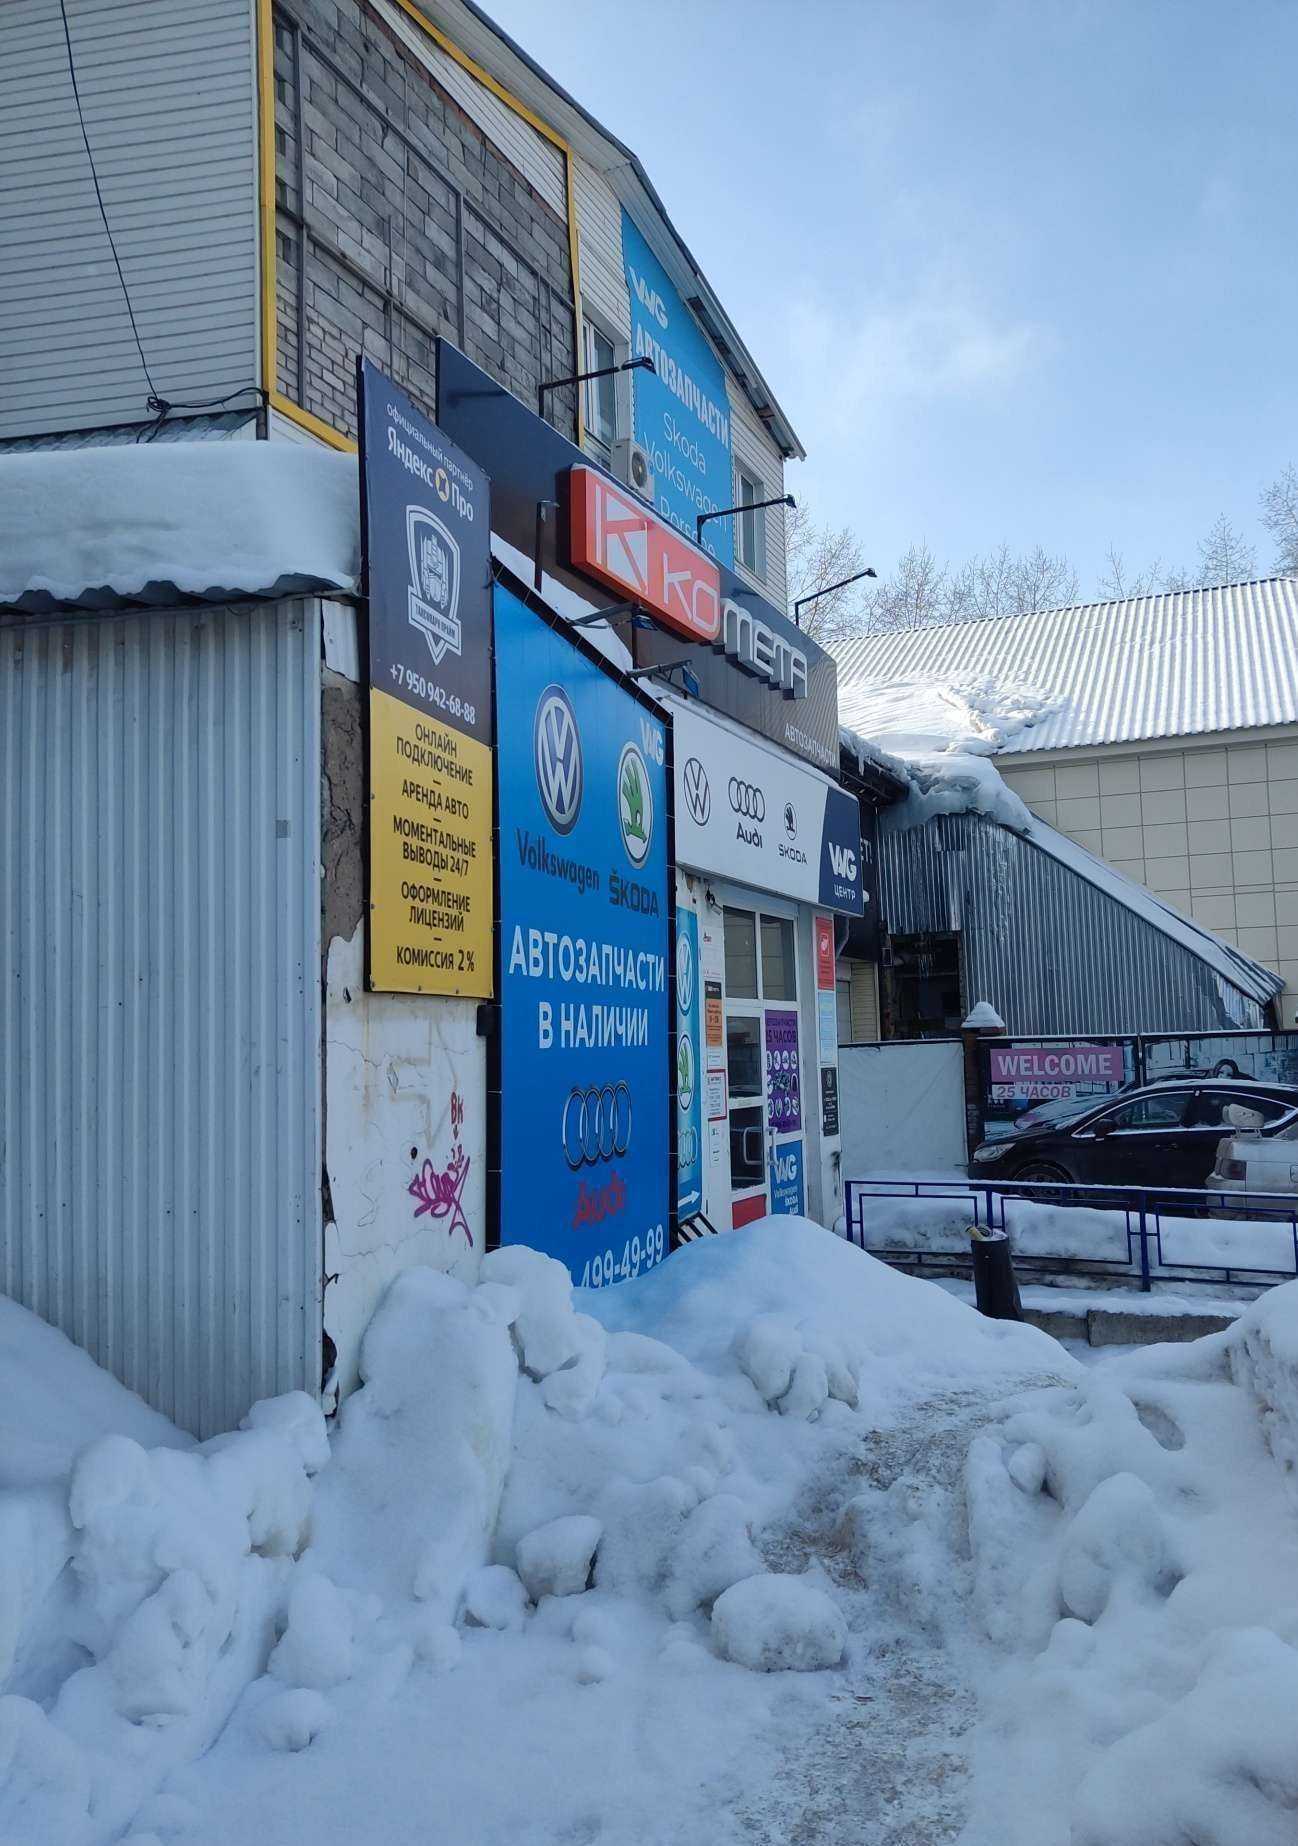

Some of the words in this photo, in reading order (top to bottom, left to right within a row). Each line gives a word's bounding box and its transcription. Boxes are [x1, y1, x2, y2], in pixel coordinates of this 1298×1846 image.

[636, 321, 729, 450] АВТОЗАПЧАСТИ
[386, 402, 443, 464] официальный
[664, 411, 707, 476] Skoda
[387, 426, 434, 488] Яндекс
[451, 482, 474, 521] Про
[390, 663, 405, 688] +7
[405, 667, 426, 699] 950
[427, 678, 476, 725] 942-68-88
[396, 735, 473, 786] ПОДКЛЮЧЕНИЕ
[415, 723, 457, 758] ОНЛАЙН
[784, 722, 837, 770] АВТОЗАПЧАСТИ
[401, 779, 443, 813] АРЕНДА
[444, 798, 469, 820] АВТО
[393, 814, 476, 858] МОМЕНТАЛЬНЫЕ
[402, 842, 449, 872] ВЫВОДЫ
[450, 855, 469, 877] 24/7
[736, 822, 763, 849] Audi
[516, 826, 600, 897] Volkswagen
[401, 881, 470, 913] ОФОРМЛЕНИЕ
[608, 868, 660, 919] ŠKODA
[834, 884, 856, 902] ЦЕНТР
[409, 905, 464, 932] ЛИЦЕНЗИЙ
[396, 945, 454, 971] КОМИССИЯ
[507, 924, 665, 993] АВТОЗАПЧАСТИ
[538, 1001, 554, 1049] В
[560, 1002, 648, 1048] НАЛИЧИИ
[998, 1054, 1113, 1076] WELCOME
[997, 1086, 1015, 1098] 25
[1020, 1086, 1072, 1099] ЧАСОВ
[572, 1169, 625, 1231] Audi
